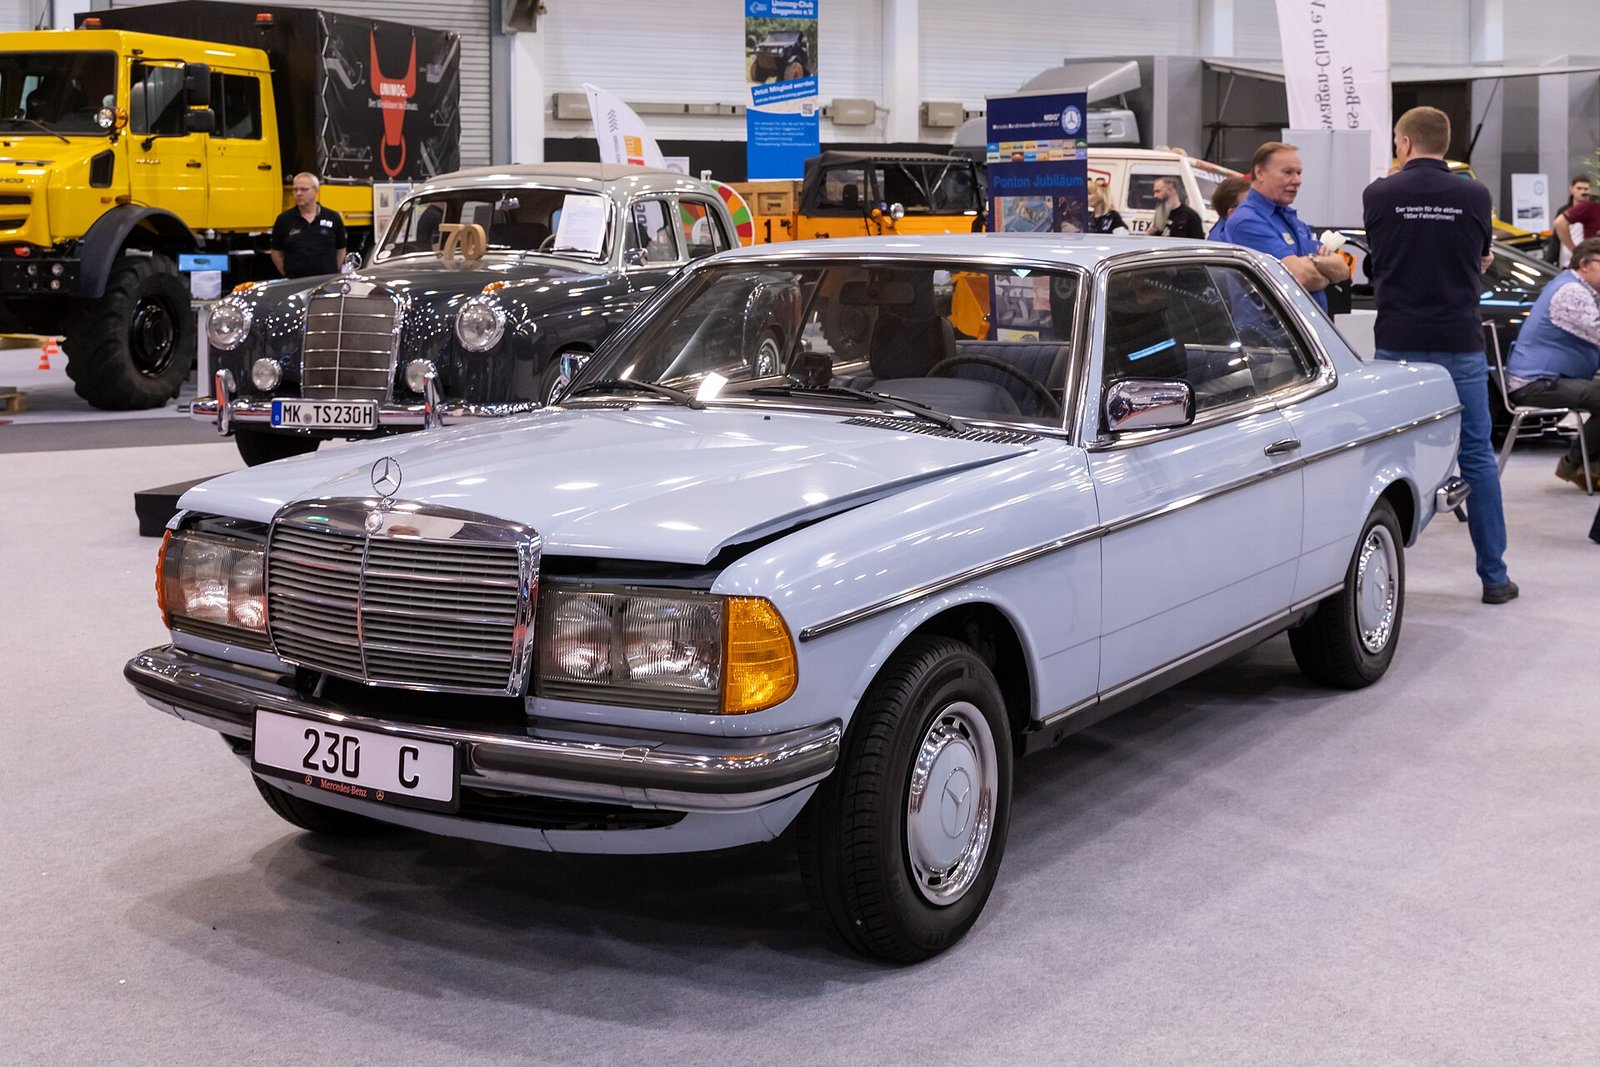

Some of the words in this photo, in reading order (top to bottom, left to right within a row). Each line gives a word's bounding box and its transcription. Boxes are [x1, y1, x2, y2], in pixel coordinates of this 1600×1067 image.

[769, 83, 793, 93] Mitglied
[993, 175, 1031, 188] Ponton
[1033, 172, 1084, 187] Jubiläum
[438, 223, 487, 260] 70
[283, 405, 301, 423] MK
[302, 728, 361, 779] 230
[398, 745, 420, 789] C
[320, 778, 367, 798] Mercedes-Benz
